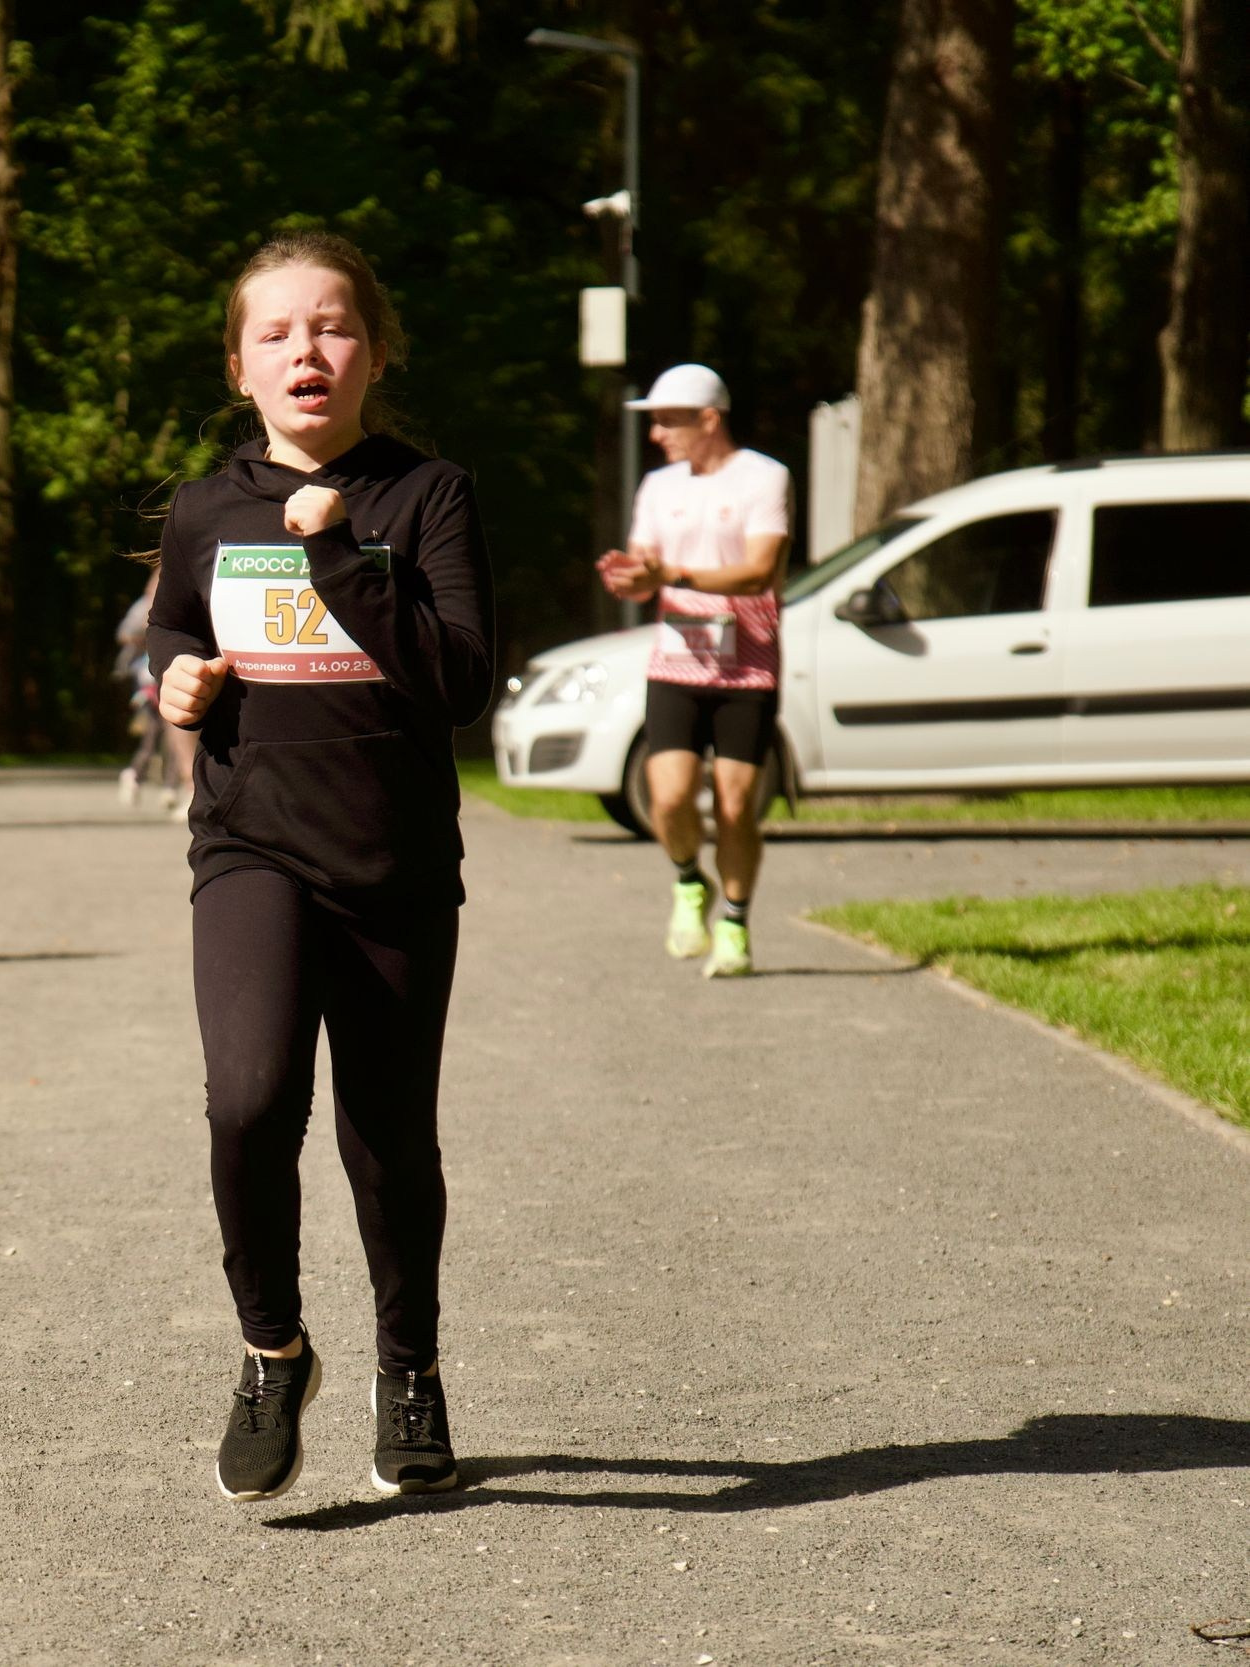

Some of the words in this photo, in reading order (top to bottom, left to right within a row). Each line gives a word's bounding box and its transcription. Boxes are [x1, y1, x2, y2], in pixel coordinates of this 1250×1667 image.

[232, 557, 295, 572] КРОСС
[265, 588, 328, 645] 52
[235, 660, 296, 672] Апрелевка
[309, 661, 371, 673] 14.09.25
